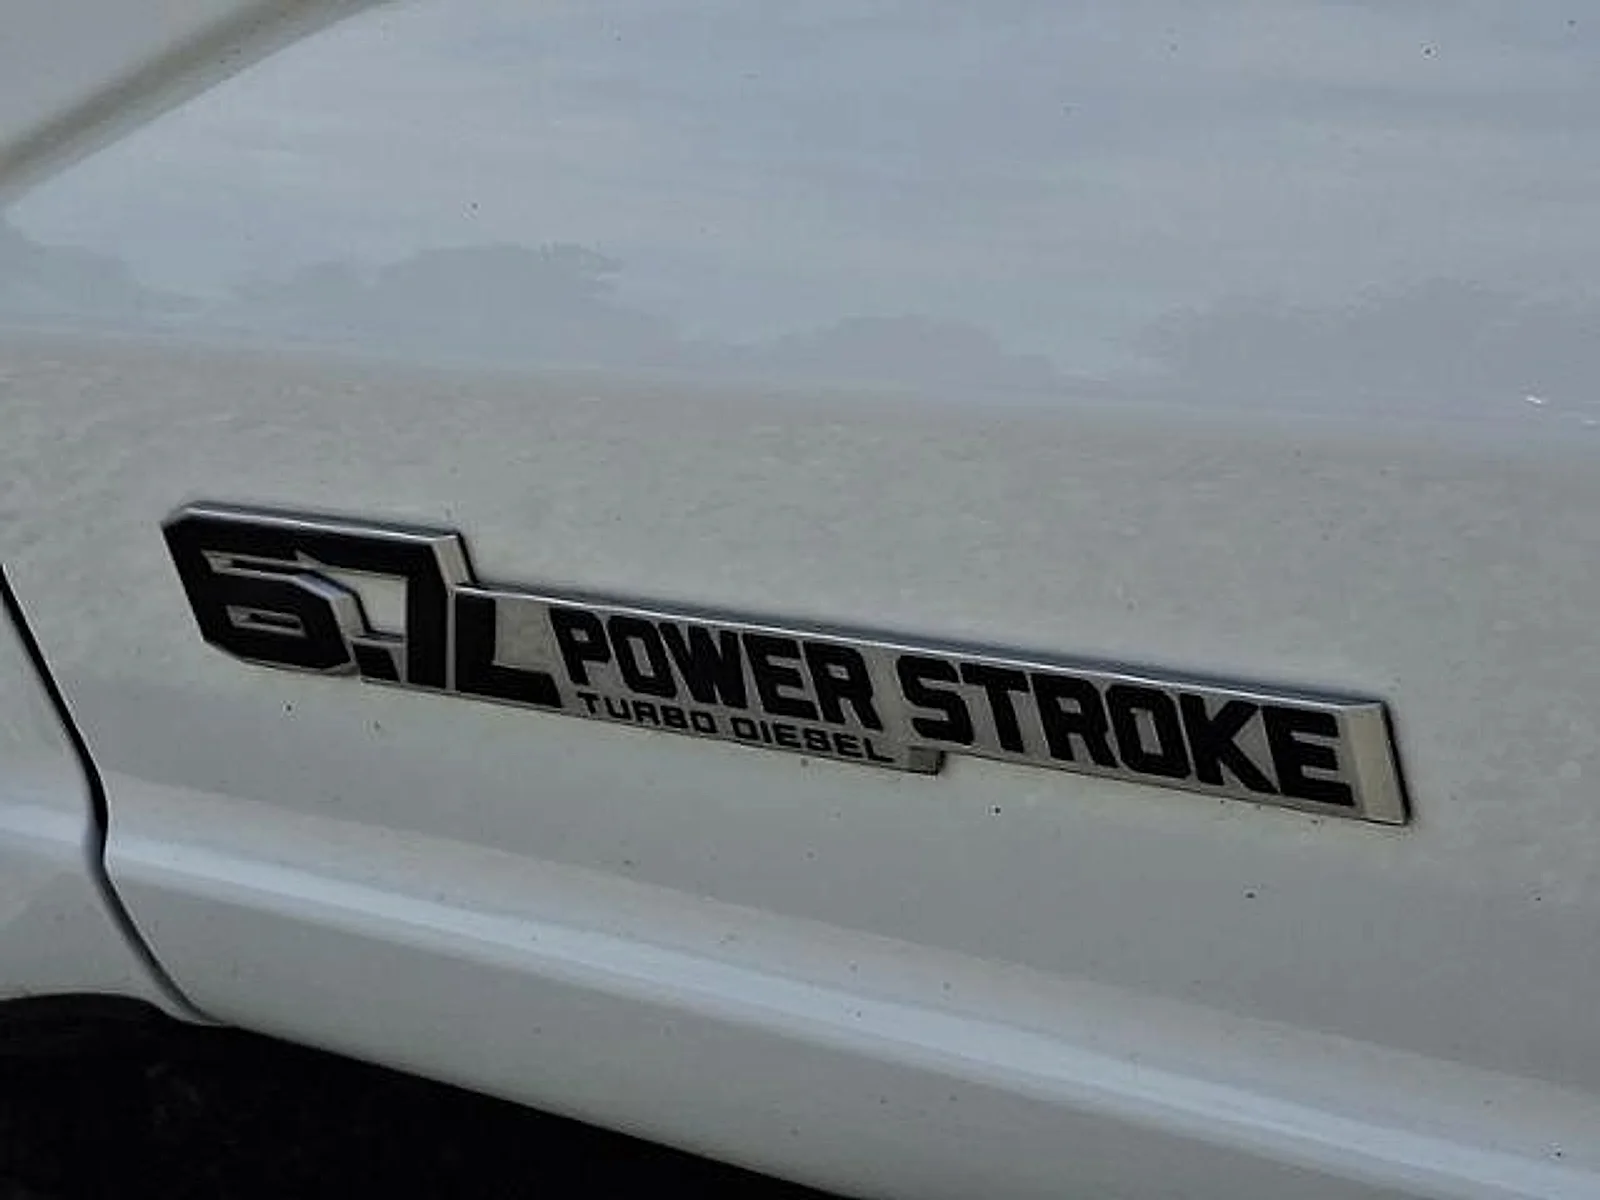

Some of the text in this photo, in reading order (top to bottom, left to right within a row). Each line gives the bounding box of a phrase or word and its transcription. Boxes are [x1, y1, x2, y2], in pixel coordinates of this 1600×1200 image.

[163, 506, 1356, 807] 6.7L POWER STROKE
[577, 691, 896, 763] TURBO DIESEL
